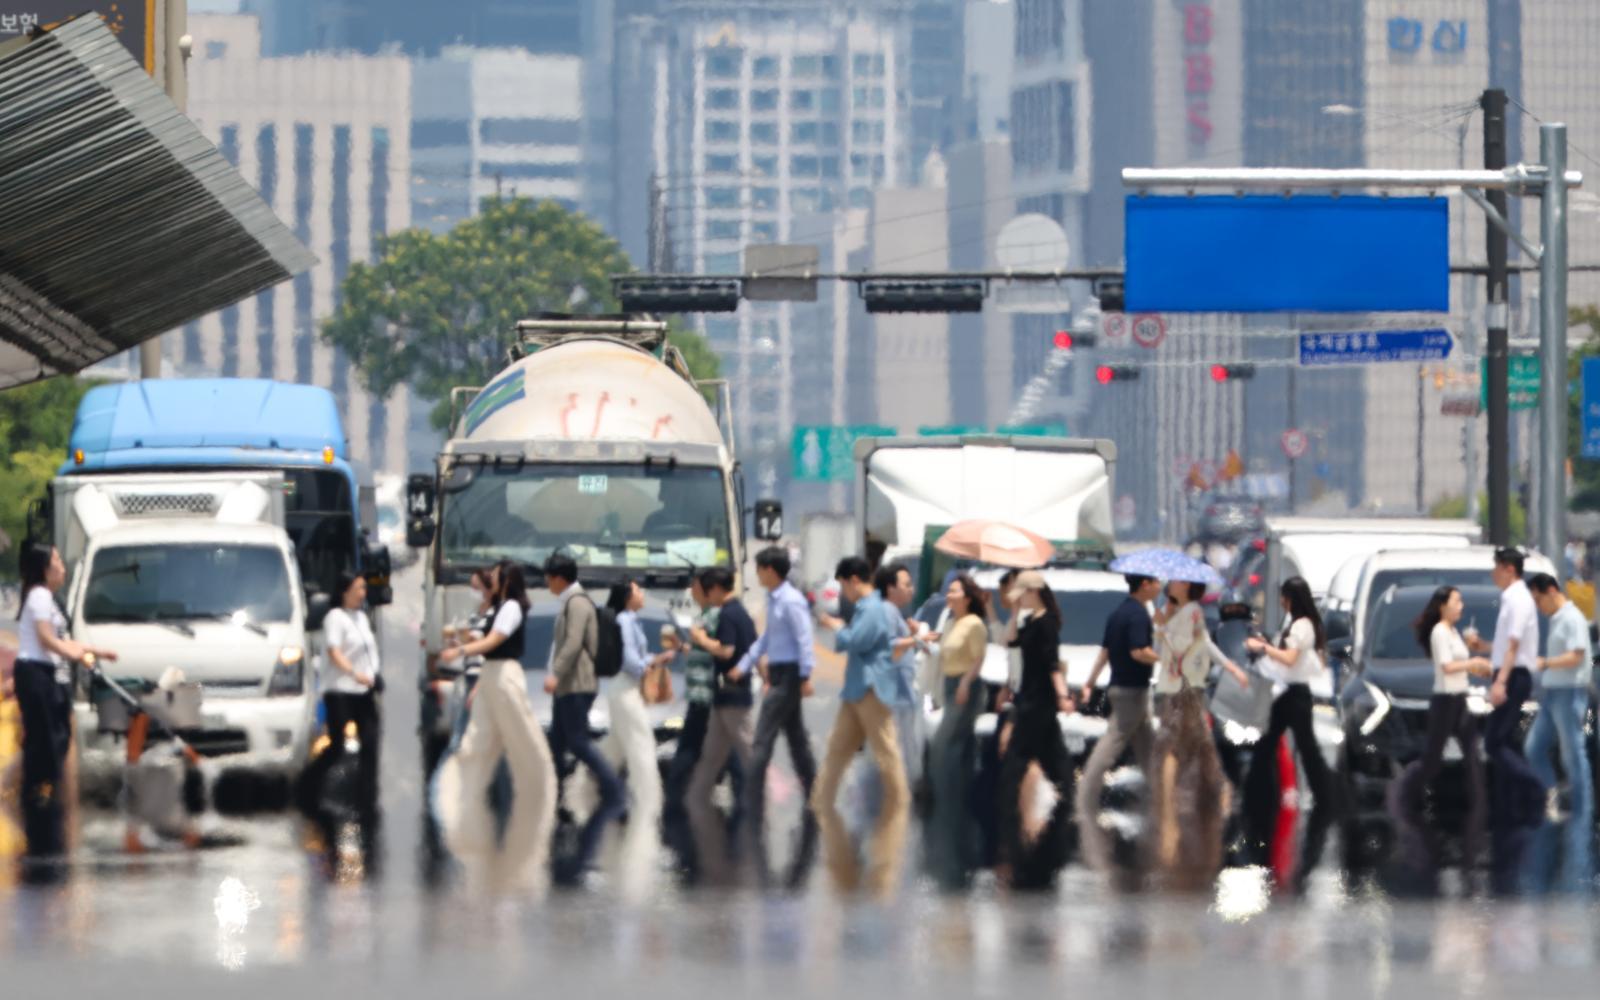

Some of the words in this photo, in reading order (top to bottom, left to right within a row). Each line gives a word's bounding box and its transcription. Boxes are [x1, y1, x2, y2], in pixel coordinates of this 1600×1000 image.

[0, 13, 38, 35] 보험
[1184, 4, 1215, 144] BBS
[411, 492, 427, 512] 14
[760, 517, 781, 536] 14
